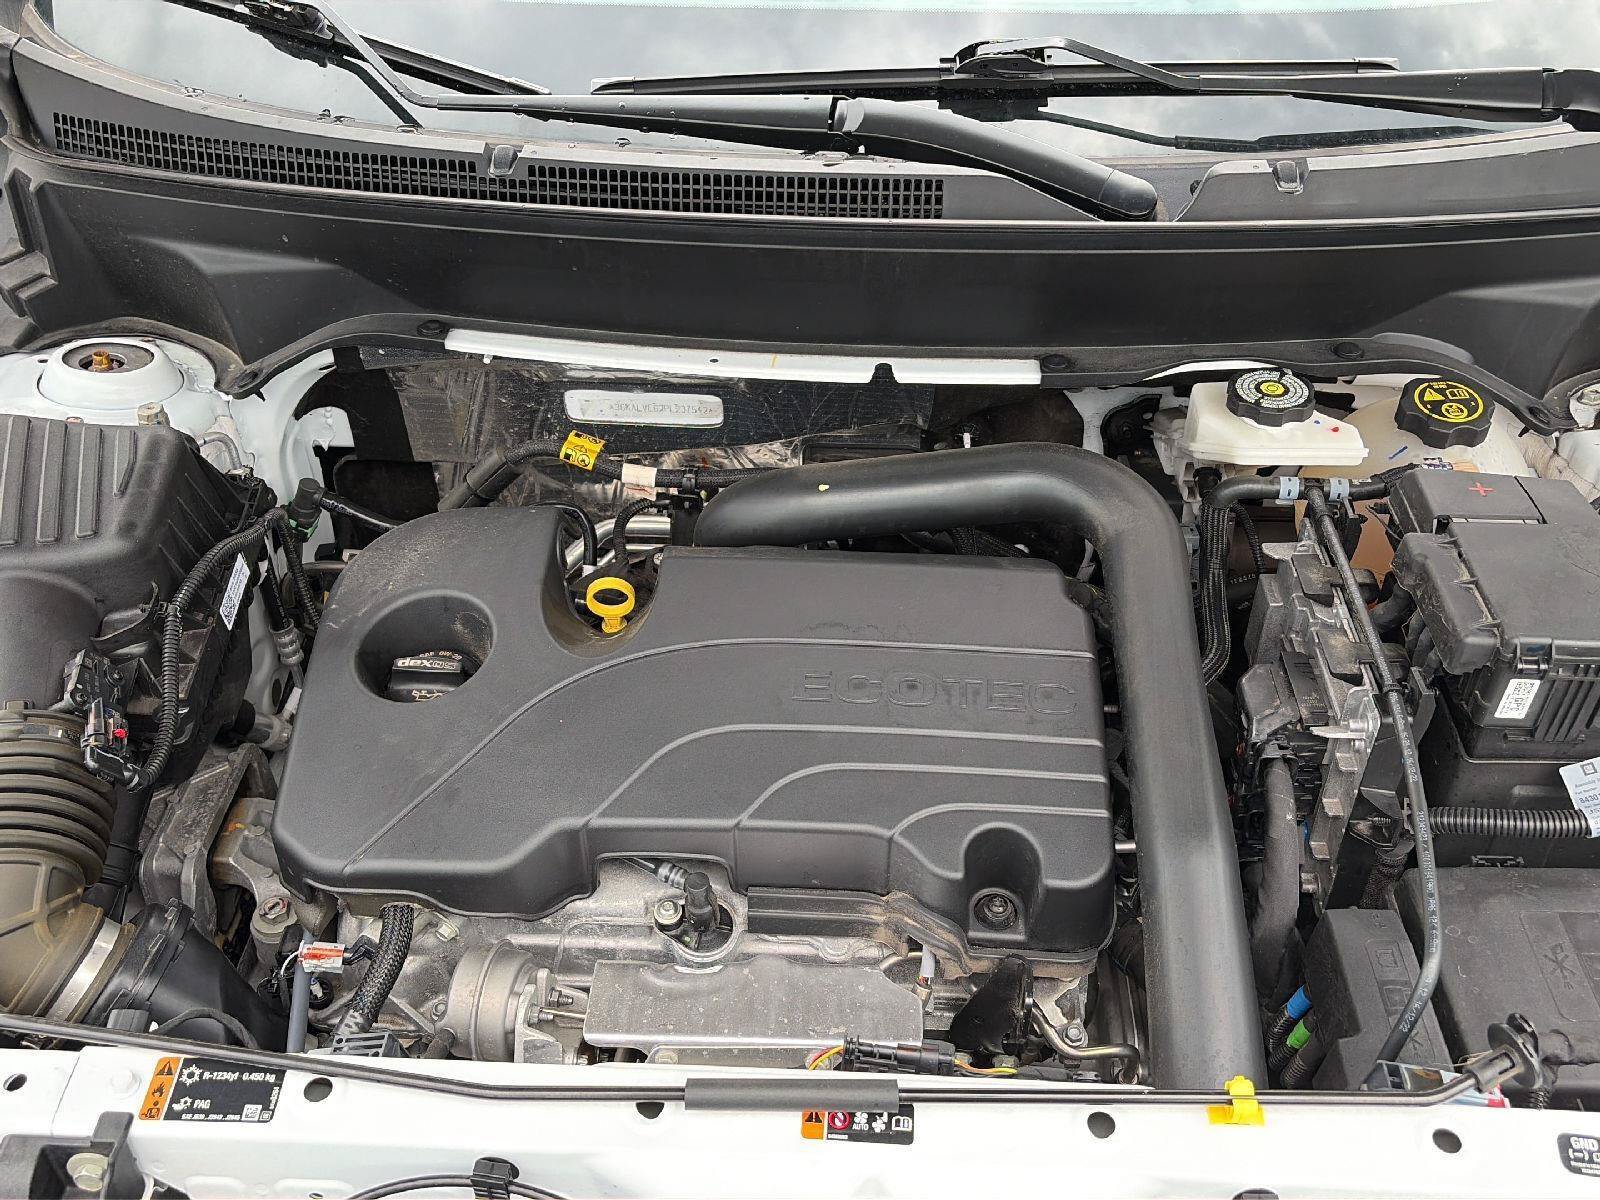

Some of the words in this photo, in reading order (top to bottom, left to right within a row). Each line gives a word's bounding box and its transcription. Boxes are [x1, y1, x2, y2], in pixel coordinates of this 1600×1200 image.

[397, 657, 457, 669] dexos
[792, 669, 1078, 714] ECOTEC
[202, 1071, 240, 1082] R-1234yf
[242, 1072, 265, 1081] 0.450
[265, 1072, 276, 1083] kg
[193, 1099, 211, 1109] PAG
[852, 1123, 869, 1131] AUTO
[1570, 1136, 1599, 1152] GND
